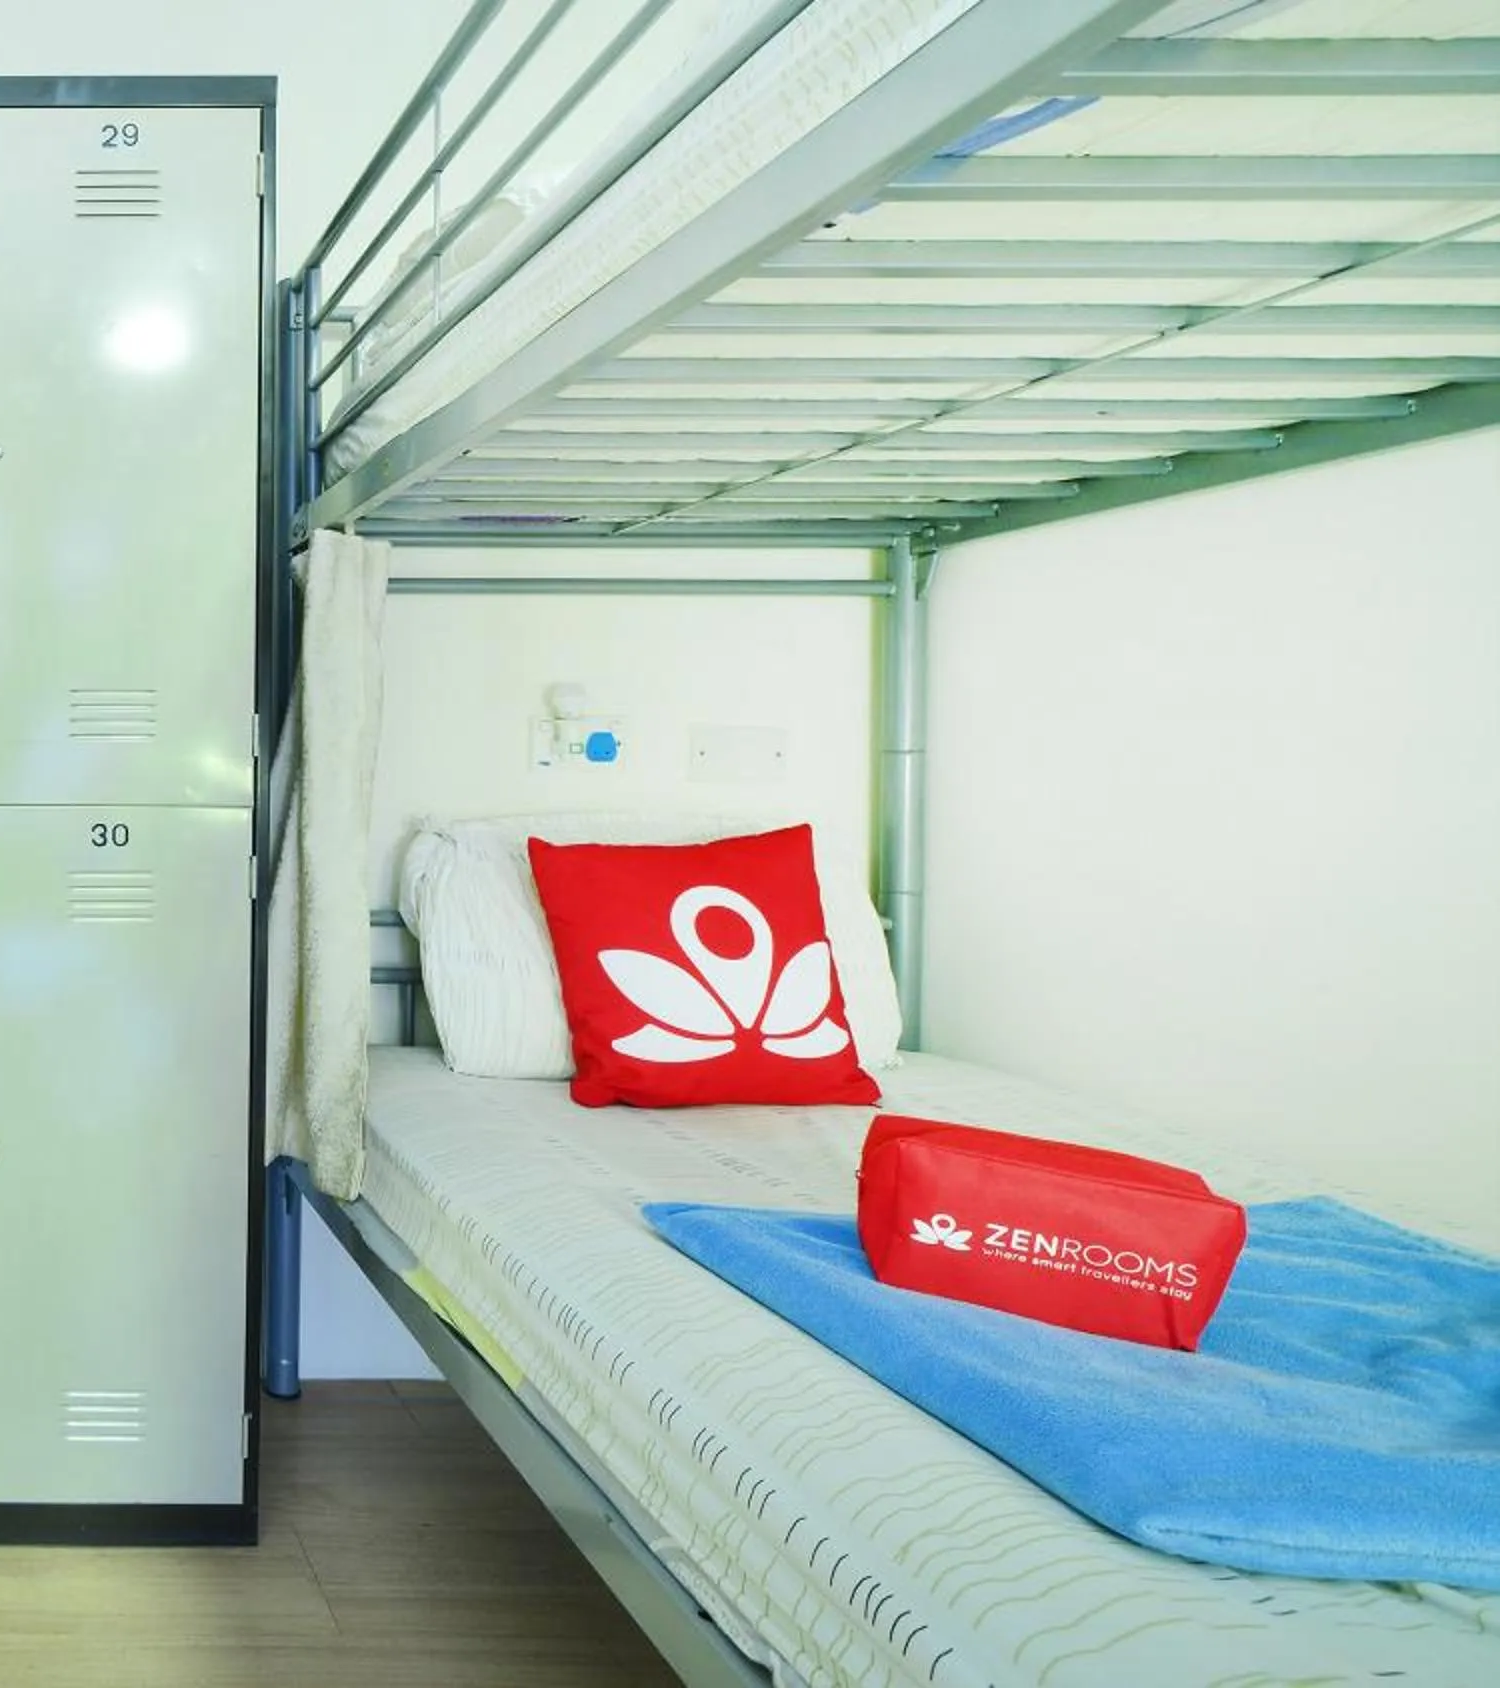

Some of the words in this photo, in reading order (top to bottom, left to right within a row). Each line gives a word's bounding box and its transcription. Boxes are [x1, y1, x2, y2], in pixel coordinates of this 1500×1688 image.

[101, 123, 140, 148] 29
[90, 823, 130, 847] 30
[981, 1247, 1027, 1264] where
[1031, 1256, 1077, 1275] smart
[1080, 1266, 1157, 1292] travellers
[1159, 1284, 1193, 1302] stay
[984, 1223, 1198, 1288] ZENROOMS
